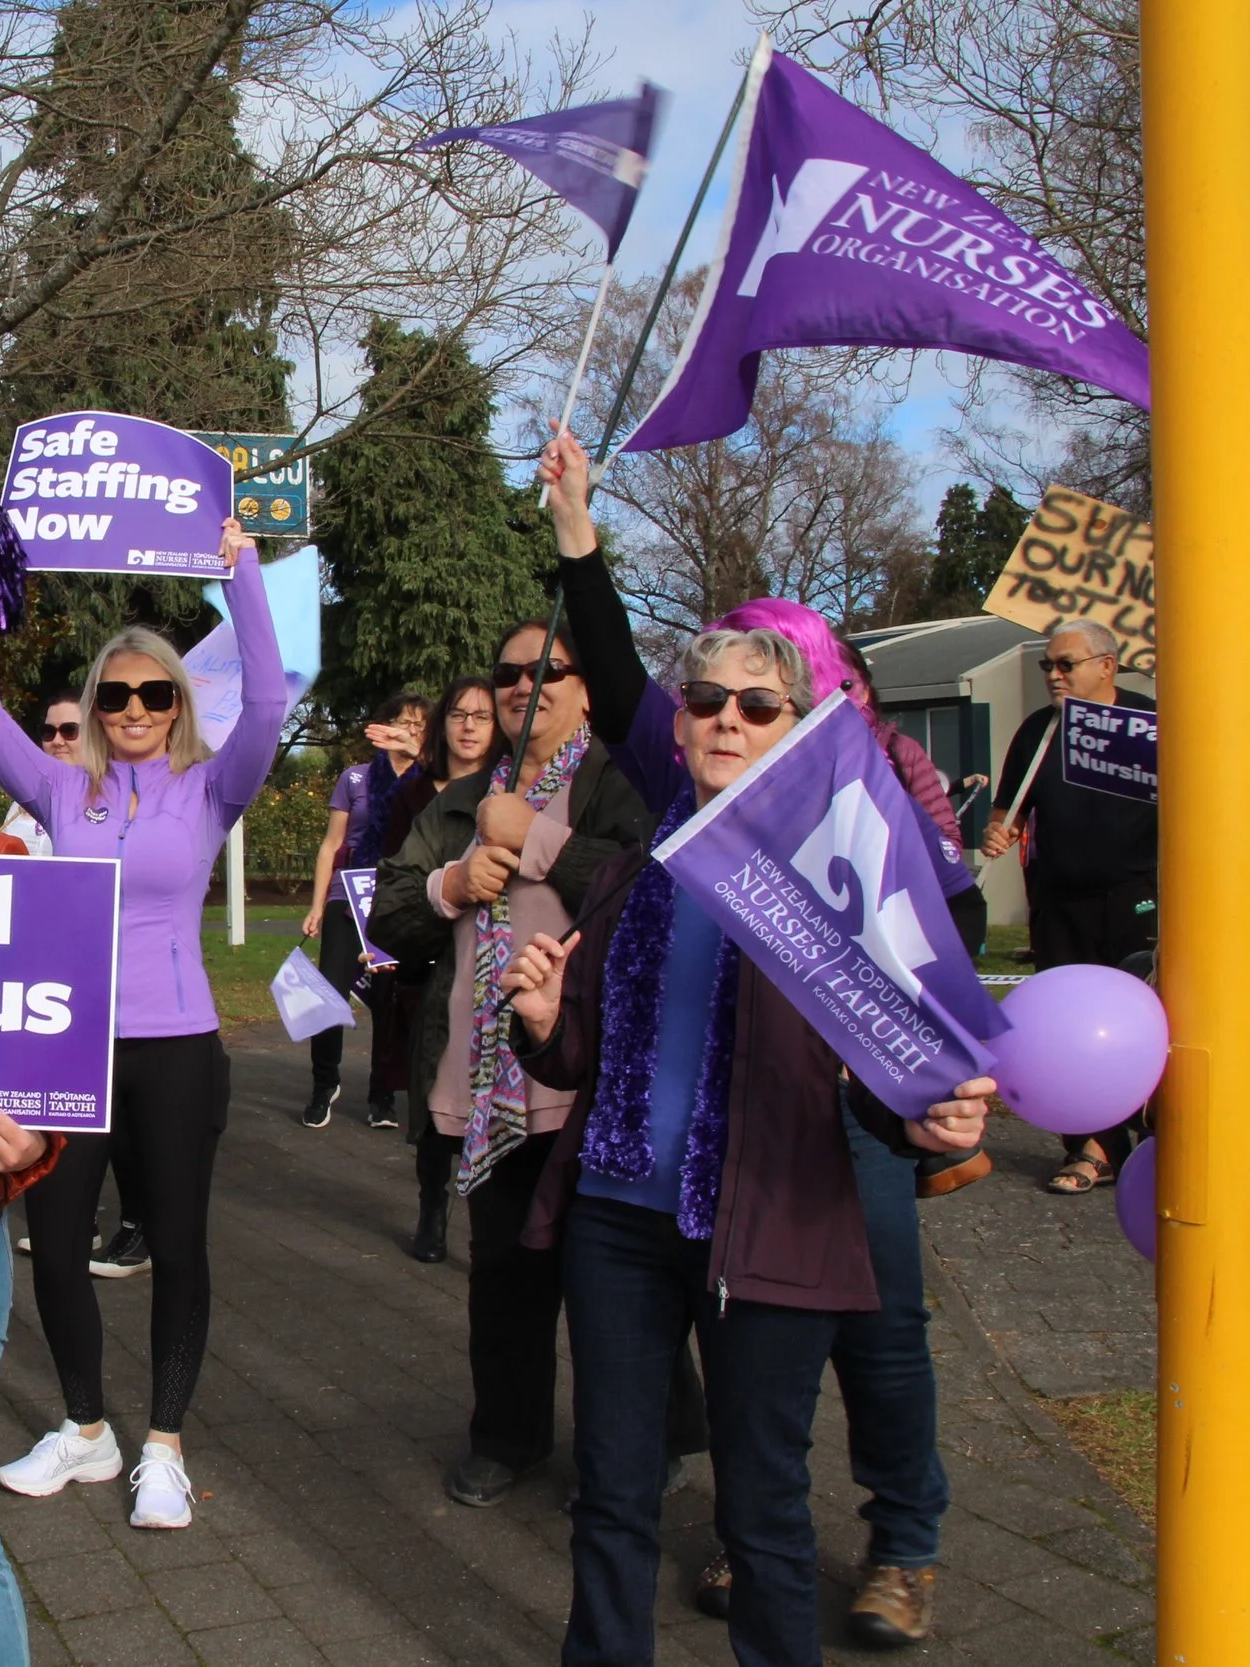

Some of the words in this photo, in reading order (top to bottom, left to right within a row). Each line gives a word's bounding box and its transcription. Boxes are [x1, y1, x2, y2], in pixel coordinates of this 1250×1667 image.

[866, 169, 962, 210] NEW
[828, 191, 1117, 329] NURSES
[810, 232, 1088, 345] ORGANISATION
[18, 419, 119, 463] Safe
[8, 462, 202, 515] Staffing
[7, 506, 114, 541] Now
[155, 555, 188, 563] NURSES
[1021, 537, 1117, 588] OUR
[1068, 726, 1110, 753] for
[1069, 704, 1124, 734] Fair
[1127, 716, 1158, 742] Pa
[1069, 748, 1158, 788] Nursin
[729, 862, 827, 960] NURSES
[750, 848, 786, 885] NEW
[779, 881, 842, 948] ZEALAND
[713, 881, 804, 974] ORGANISATION
[812, 985, 849, 1025] KAITIAKI
[847, 1022, 858, 1033] O
[854, 1031, 905, 1084] AOTEAROA
[825, 968, 931, 1074] TAPUHI
[48, 1100, 96, 1113] TAPUHI
